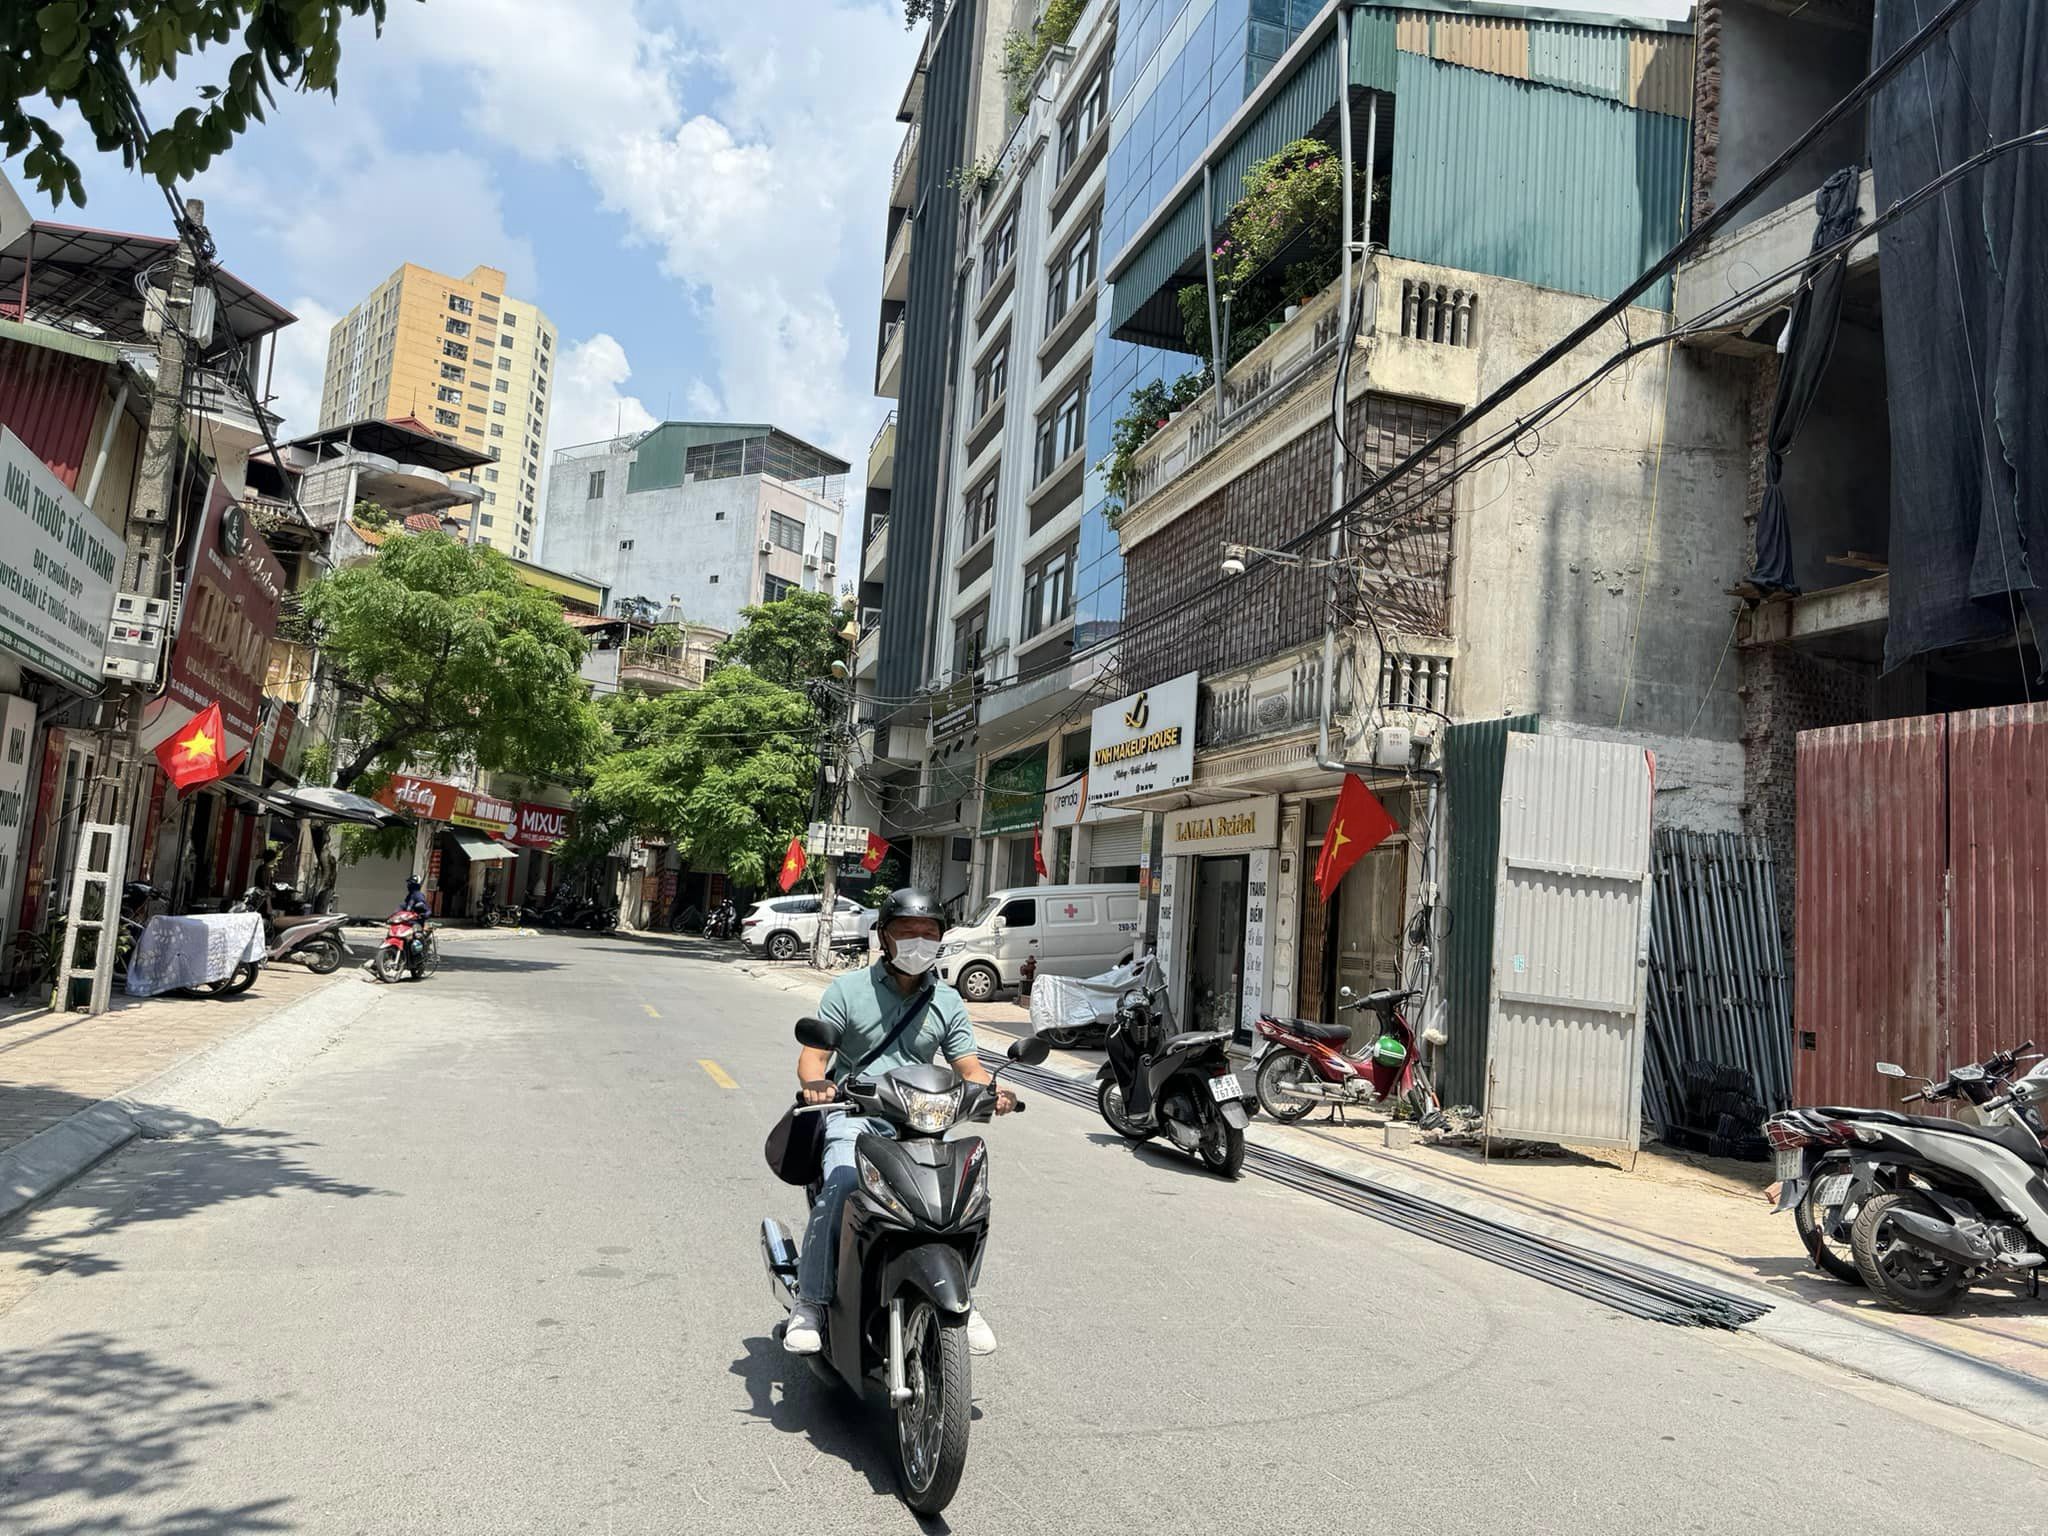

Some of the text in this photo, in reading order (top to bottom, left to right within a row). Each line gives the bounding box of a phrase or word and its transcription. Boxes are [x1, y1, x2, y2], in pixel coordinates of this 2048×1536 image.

[4, 461, 116, 585] NHÀ THUỐC TẤN THÀNH
[8, 722, 26, 766] NHÀ
[1113, 736, 1148, 762] MAKEUP
[1147, 726, 1181, 753] HOUSE
[521, 808, 569, 835] MIXUE
[1216, 811, 1256, 838] Bridal
[1249, 881, 1266, 897] TRANG
